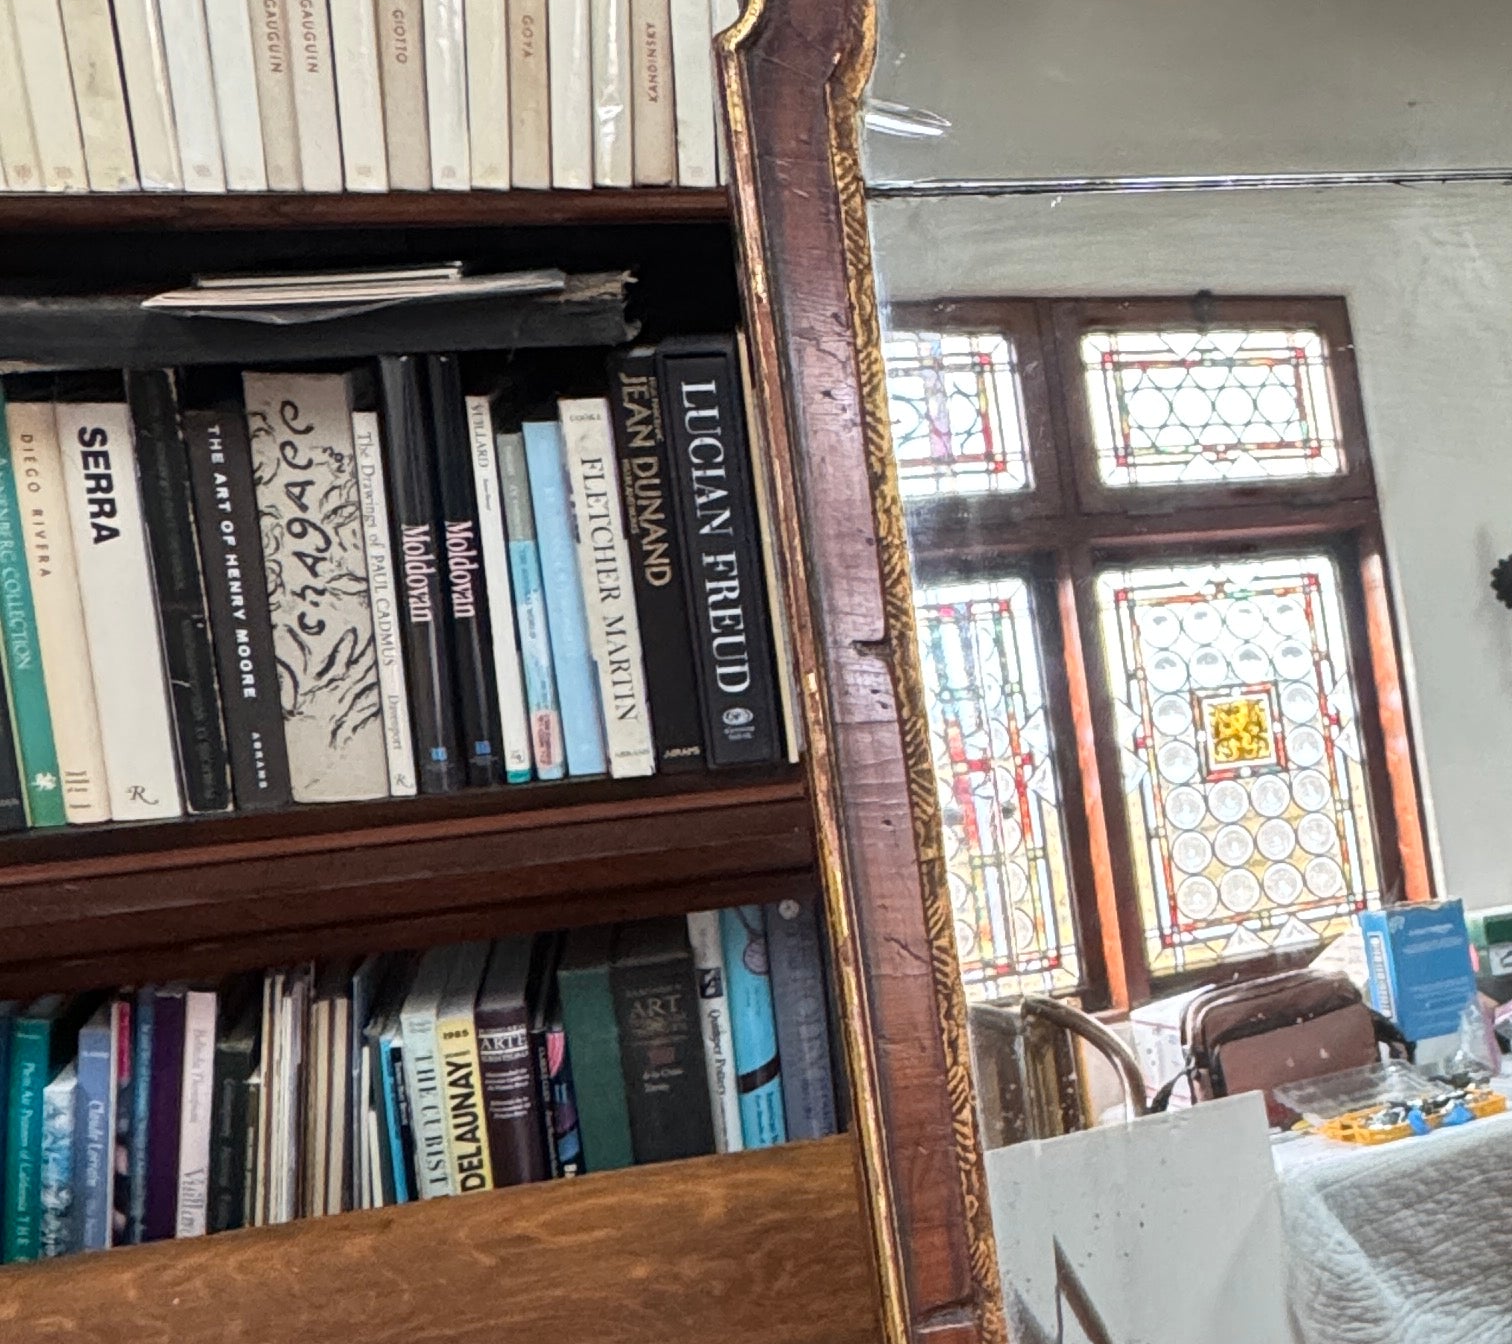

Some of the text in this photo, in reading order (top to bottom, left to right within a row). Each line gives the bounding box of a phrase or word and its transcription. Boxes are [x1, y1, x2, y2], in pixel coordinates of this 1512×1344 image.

[391, 8, 409, 65] GIOTTO
[520, 14, 535, 59] GOYA
[645, 21, 659, 104] KANDINSKY
[617, 371, 656, 449] JEAN
[680, 380, 734, 537] LUCIAN
[20, 433, 53, 578] DIEGO RIVERA
[77, 425, 121, 546] SERRA
[360, 462, 380, 531] Drawings
[632, 455, 673, 587] DUNAND
[206, 424, 258, 700] THE ART OF HENRY MOORE
[368, 531, 382, 549] of
[370, 549, 389, 597] PAUL
[401, 523, 437, 624] Moldovan
[444, 519, 480, 620] Moldovan
[580, 456, 640, 723] FLETCHER MARTIN
[2, 566, 34, 672] COLLECTION
[376, 597, 398, 668] CADMUS
[702, 550, 752, 694] FREUD
[250, 730, 269, 790] ABRAMS
[442, 1029, 470, 1041] 1985
[480, 1032, 529, 1051] ARTE
[414, 1054, 450, 1186] THE CUBIST
[445, 1062, 488, 1193] DELAUNAY
